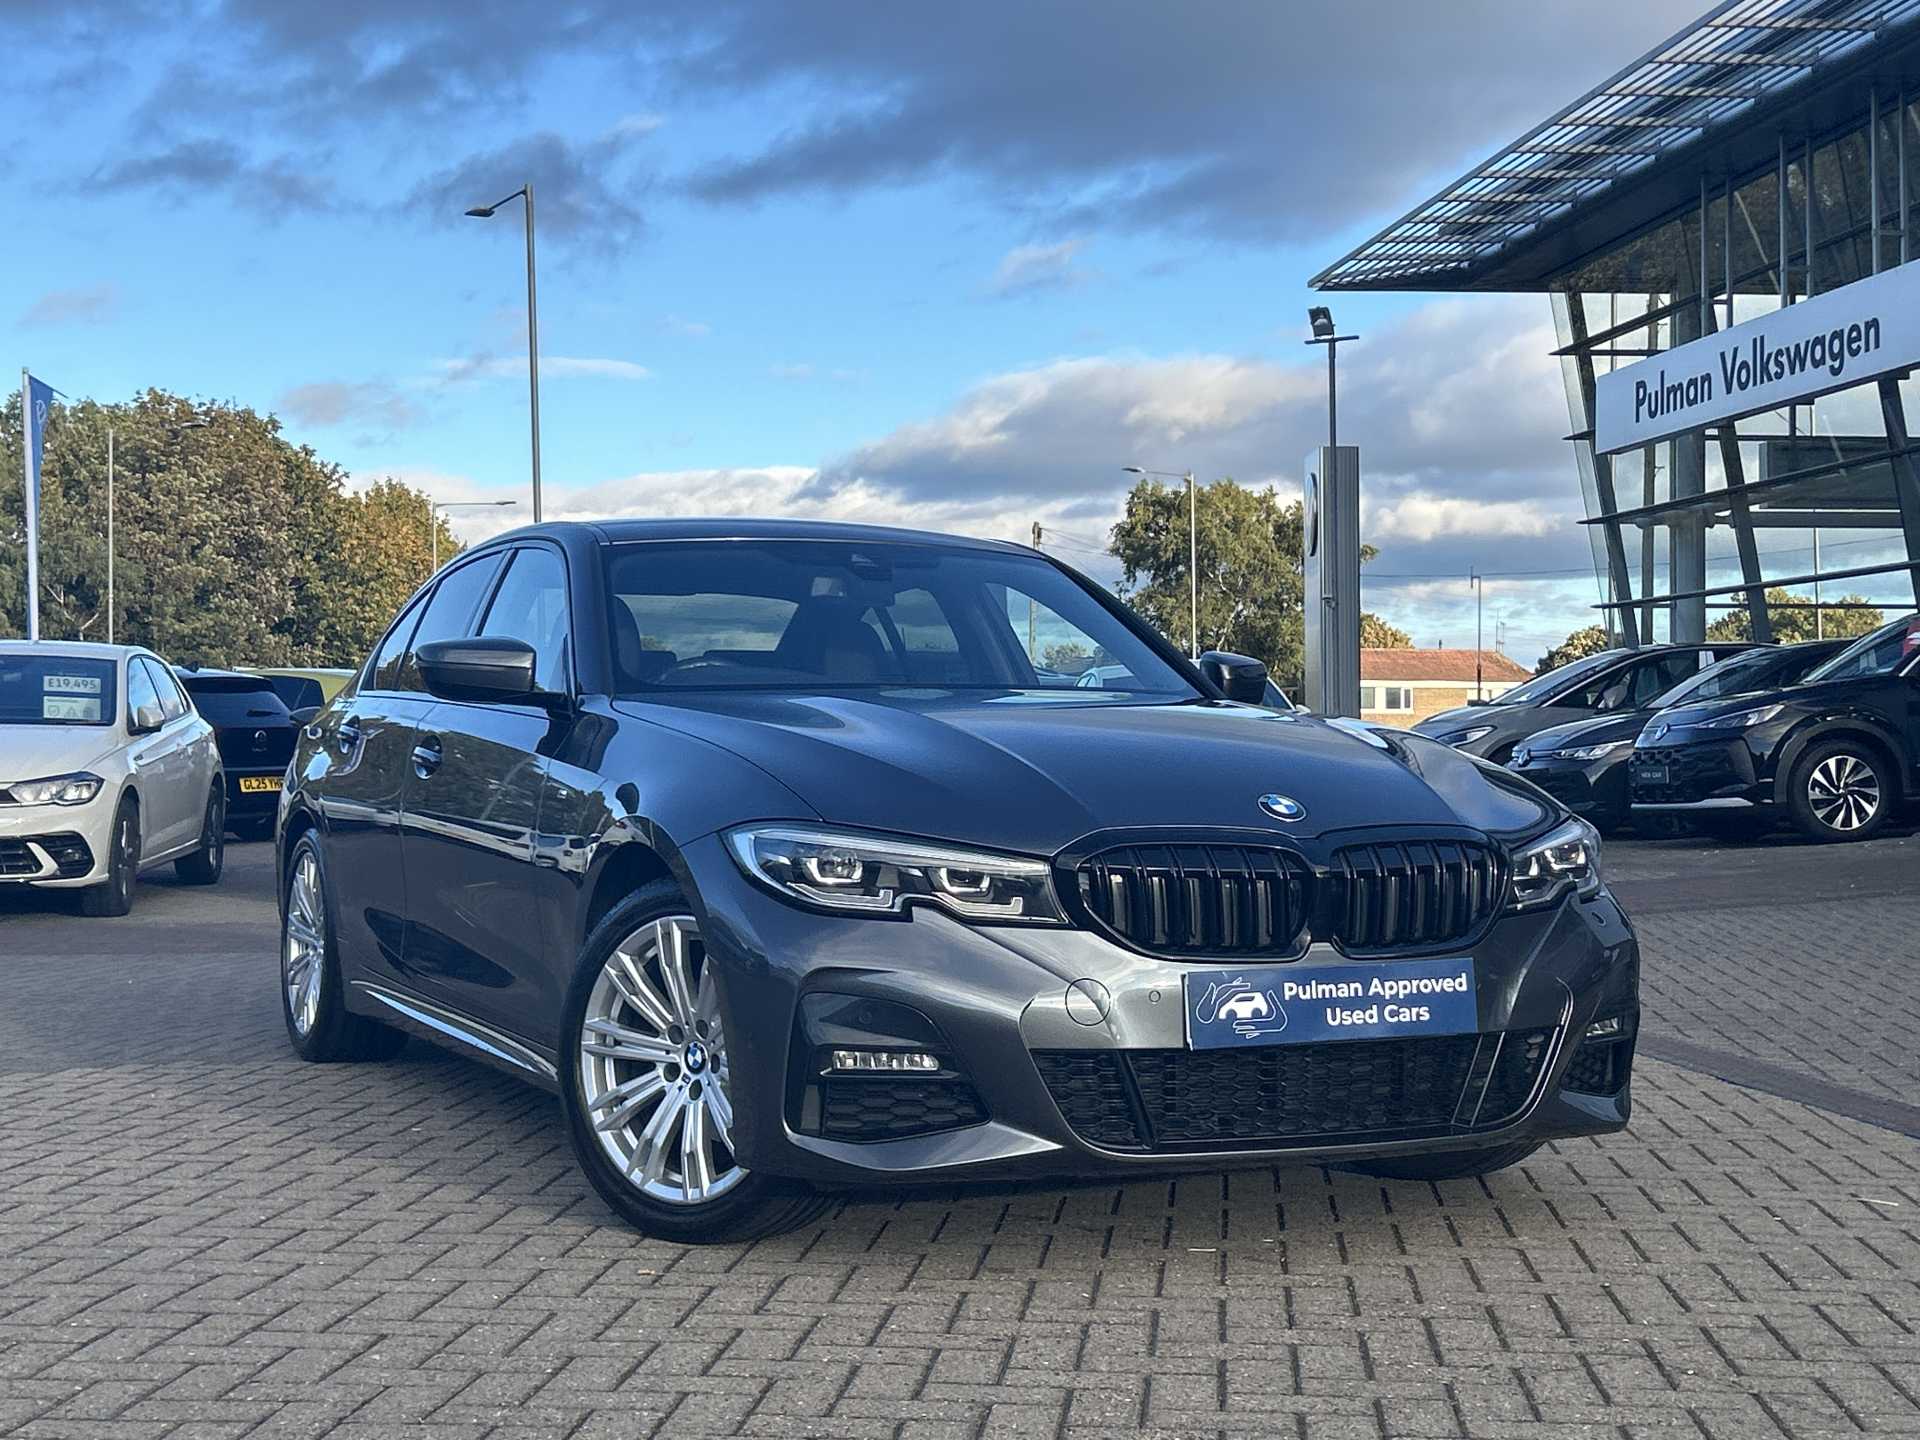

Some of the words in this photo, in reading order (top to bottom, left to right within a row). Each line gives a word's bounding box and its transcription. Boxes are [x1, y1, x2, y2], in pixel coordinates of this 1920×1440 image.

[1635, 370, 1712, 423] Pulman
[1720, 317, 1880, 377] Volkswagen
[1283, 979, 1363, 1000] Pulman
[1368, 972, 1468, 1000] Approved
[1326, 1004, 1379, 1026] Used
[1383, 1003, 1431, 1023] Cars
